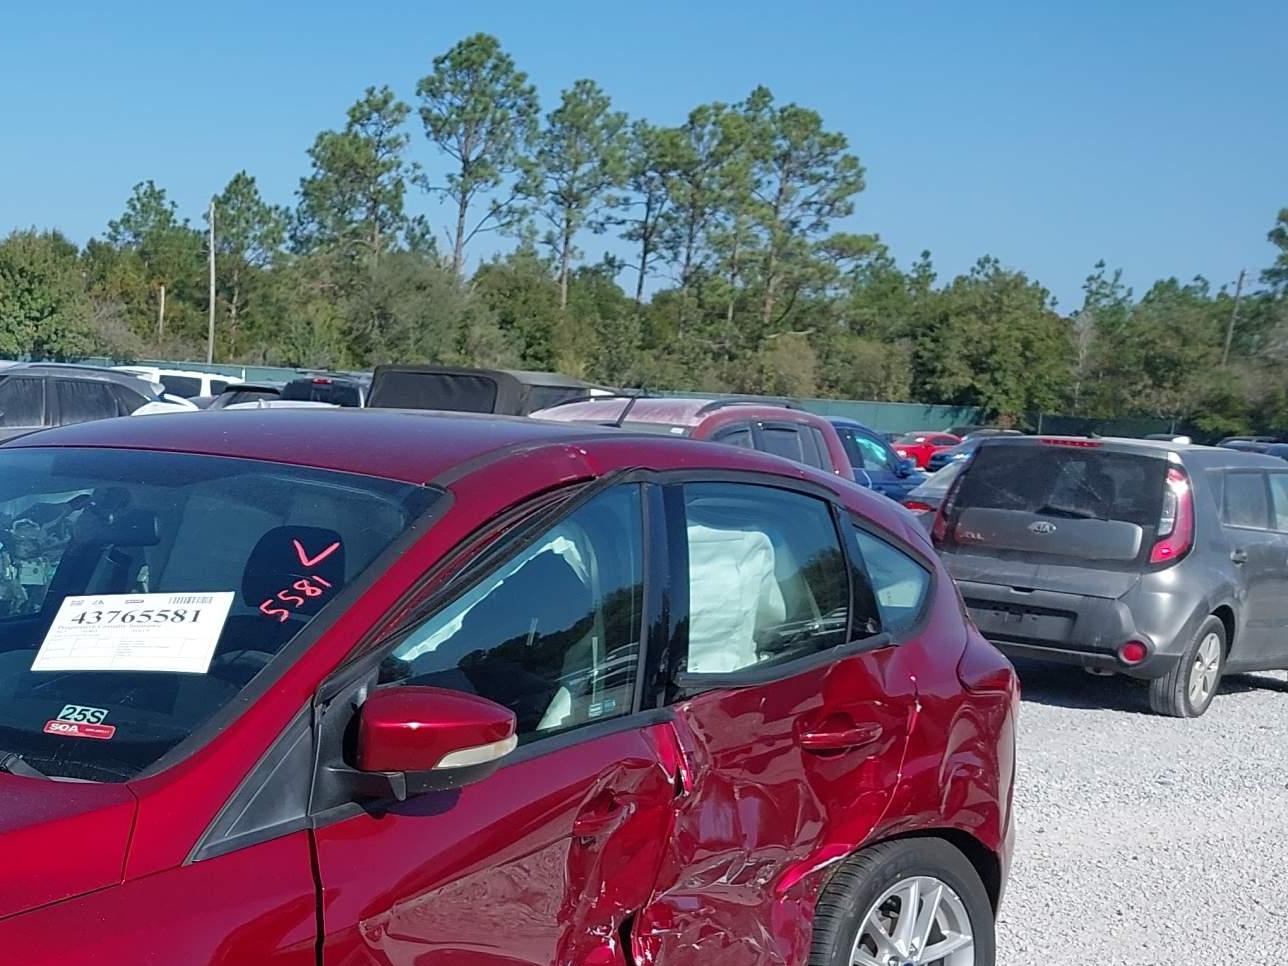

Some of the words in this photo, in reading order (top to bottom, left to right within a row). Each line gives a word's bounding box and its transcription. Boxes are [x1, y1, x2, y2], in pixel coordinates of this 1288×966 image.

[259, 575, 332, 622] 5581
[71, 609, 202, 625] 43765581
[59, 706, 105, 725] 25S
